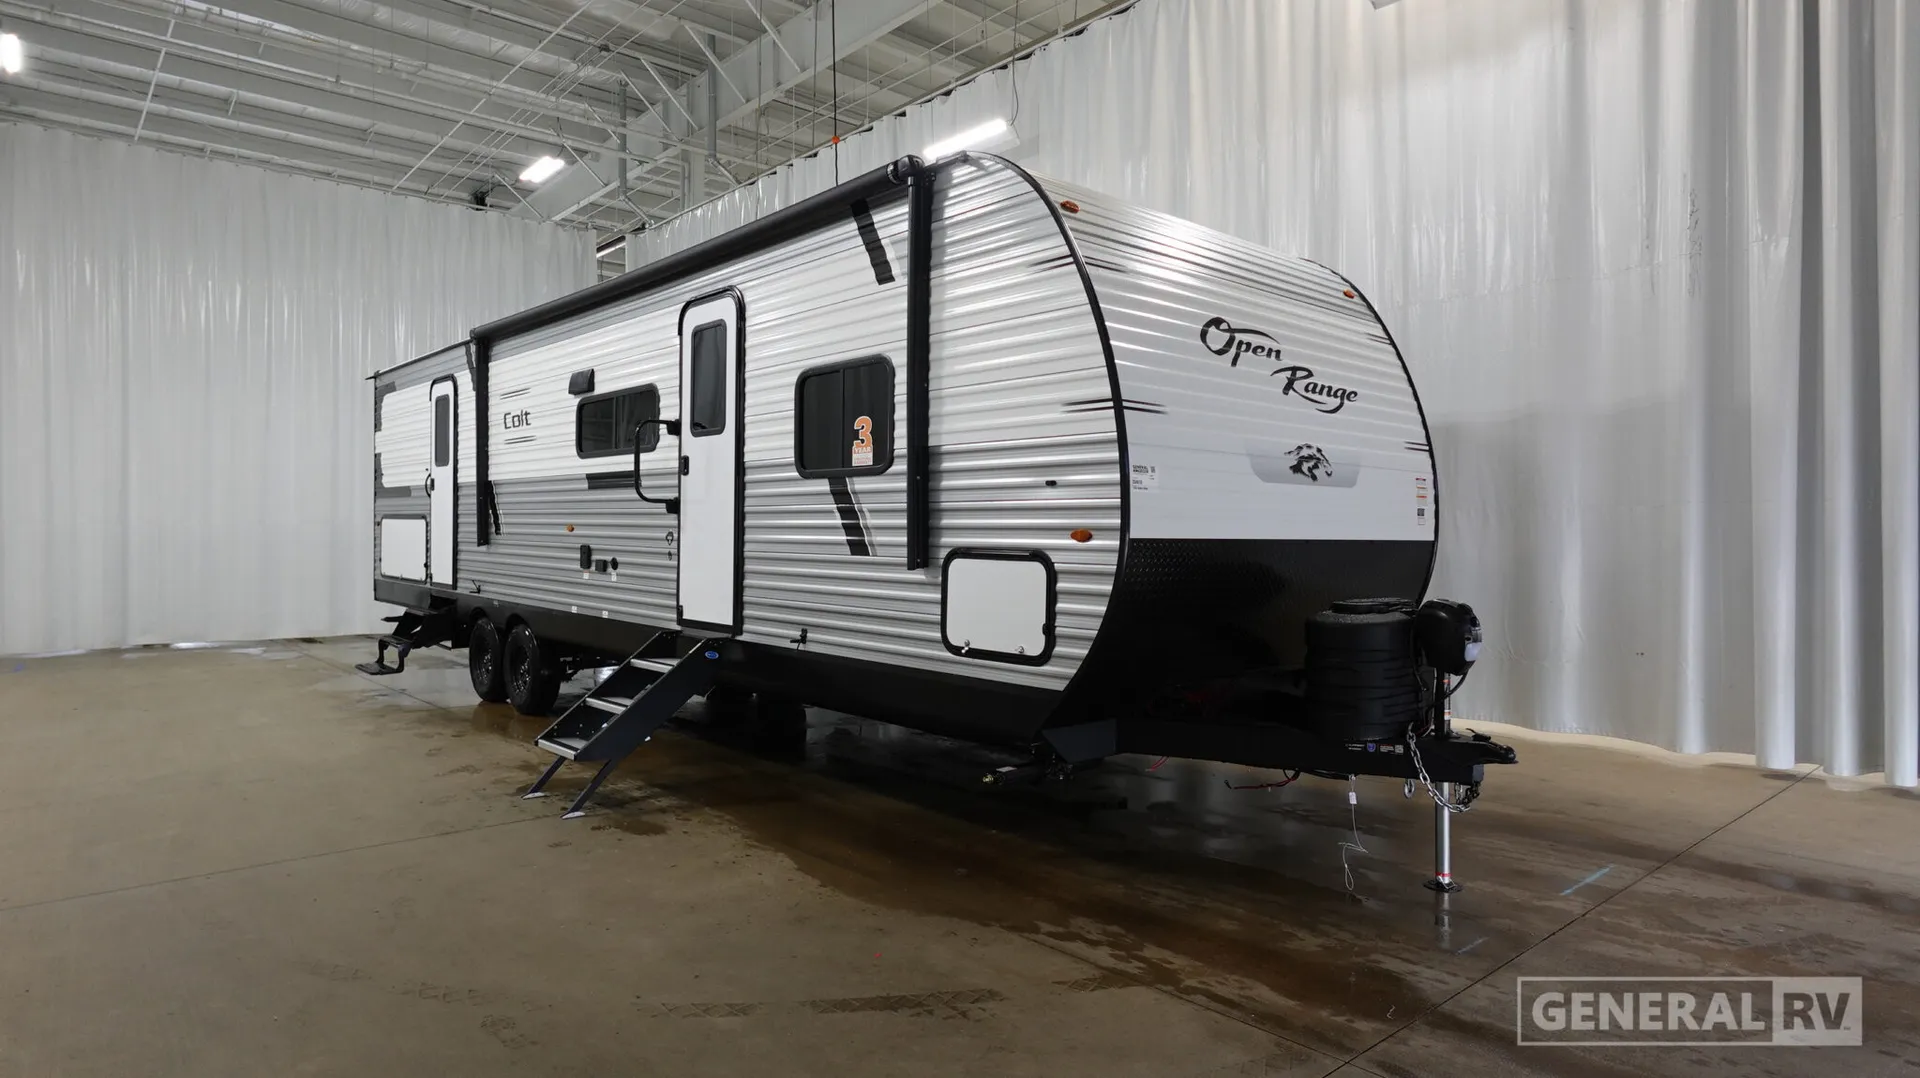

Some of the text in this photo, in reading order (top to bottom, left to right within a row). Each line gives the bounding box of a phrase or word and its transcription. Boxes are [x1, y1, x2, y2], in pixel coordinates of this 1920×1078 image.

[1200, 317, 1283, 367] Open
[1270, 366, 1358, 414] Range
[504, 410, 532, 429] Colt
[854, 416, 872, 448] 3
